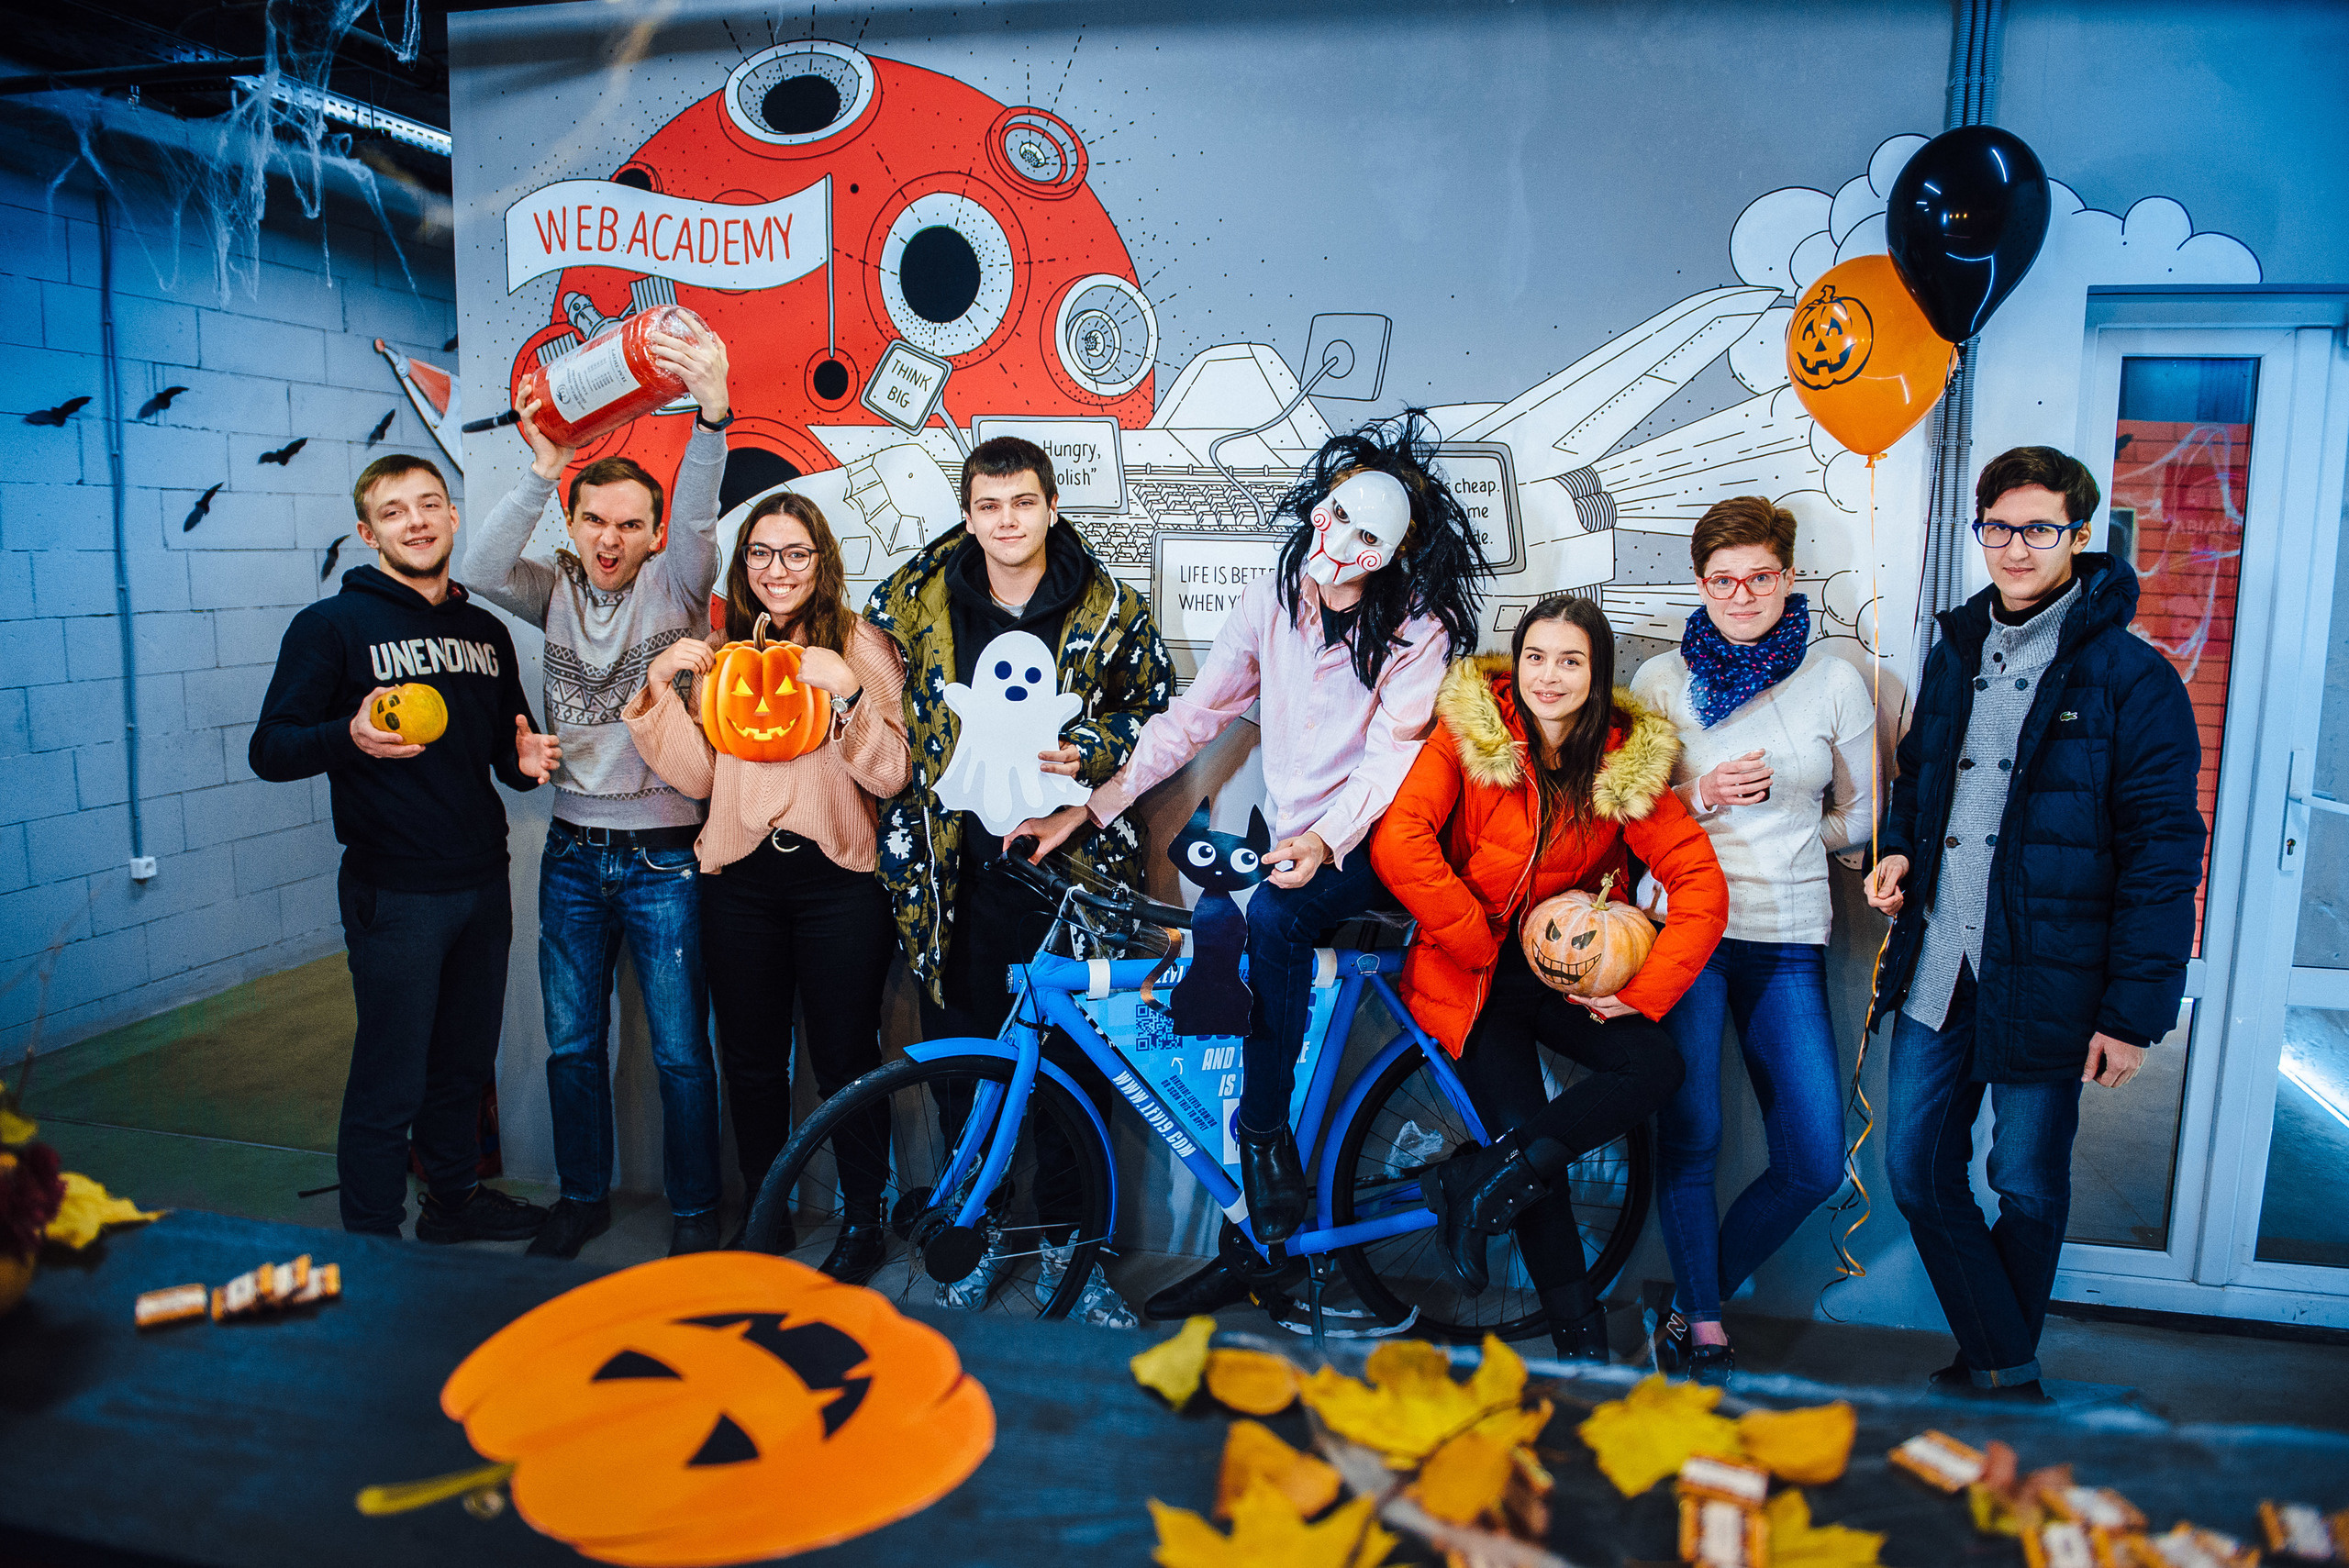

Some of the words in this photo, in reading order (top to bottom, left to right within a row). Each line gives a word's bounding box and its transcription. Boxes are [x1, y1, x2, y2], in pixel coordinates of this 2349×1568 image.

[891, 359, 932, 392] THINK
[887, 385, 910, 408] BIG
[1042, 439, 1101, 463] Hungry,
[1056, 467, 1097, 486] olish”
[1454, 477, 1500, 497] cheap.
[1467, 506, 1488, 518] me
[1180, 565, 1208, 584] LIFE
[1214, 566, 1227, 584] IS
[1178, 593, 1224, 612] WHEN
[369, 637, 499, 681] UNENDING
[1202, 1046, 1235, 1071] AND
[1218, 1073, 1236, 1096] IS
[1112, 1070, 1197, 1158] WWW.LEVI9.COM
[1177, 1098, 1192, 1112] THIS
[1192, 1116, 1209, 1131] APPLY
